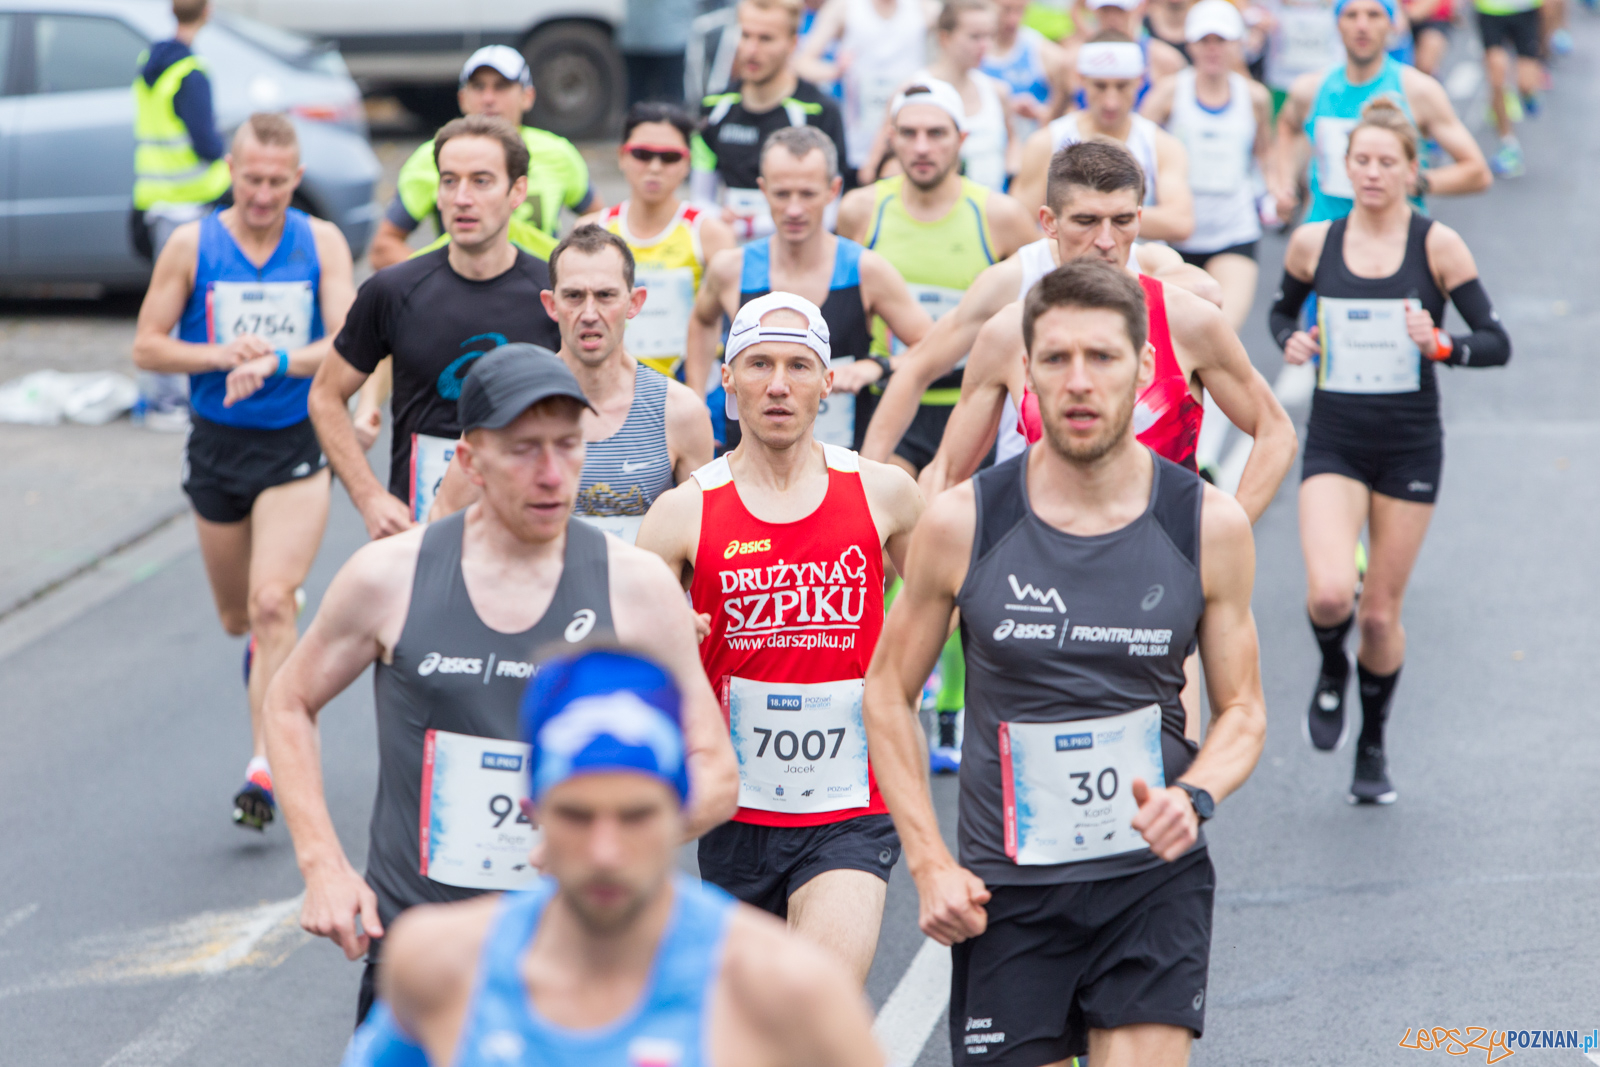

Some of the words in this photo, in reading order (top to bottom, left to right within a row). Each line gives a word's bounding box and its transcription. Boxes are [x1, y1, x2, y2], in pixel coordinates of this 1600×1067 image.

[233, 314, 294, 335] 6754
[719, 559, 846, 593] DRUŻYNA
[724, 585, 867, 632] SZPIKU
[728, 632, 855, 651] www.darszpiku.pl
[1013, 623, 1056, 639] asics
[1070, 626, 1173, 643] FRONTRUNNER
[1128, 644, 1169, 656] POLSKA
[438, 657, 483, 674] asics
[771, 698, 781, 706] 18.
[782, 699, 800, 707] PKO
[753, 727, 846, 761] 7007
[784, 764, 815, 774] Jacek
[1069, 767, 1118, 805] 30
[1084, 804, 1113, 818] Karol
